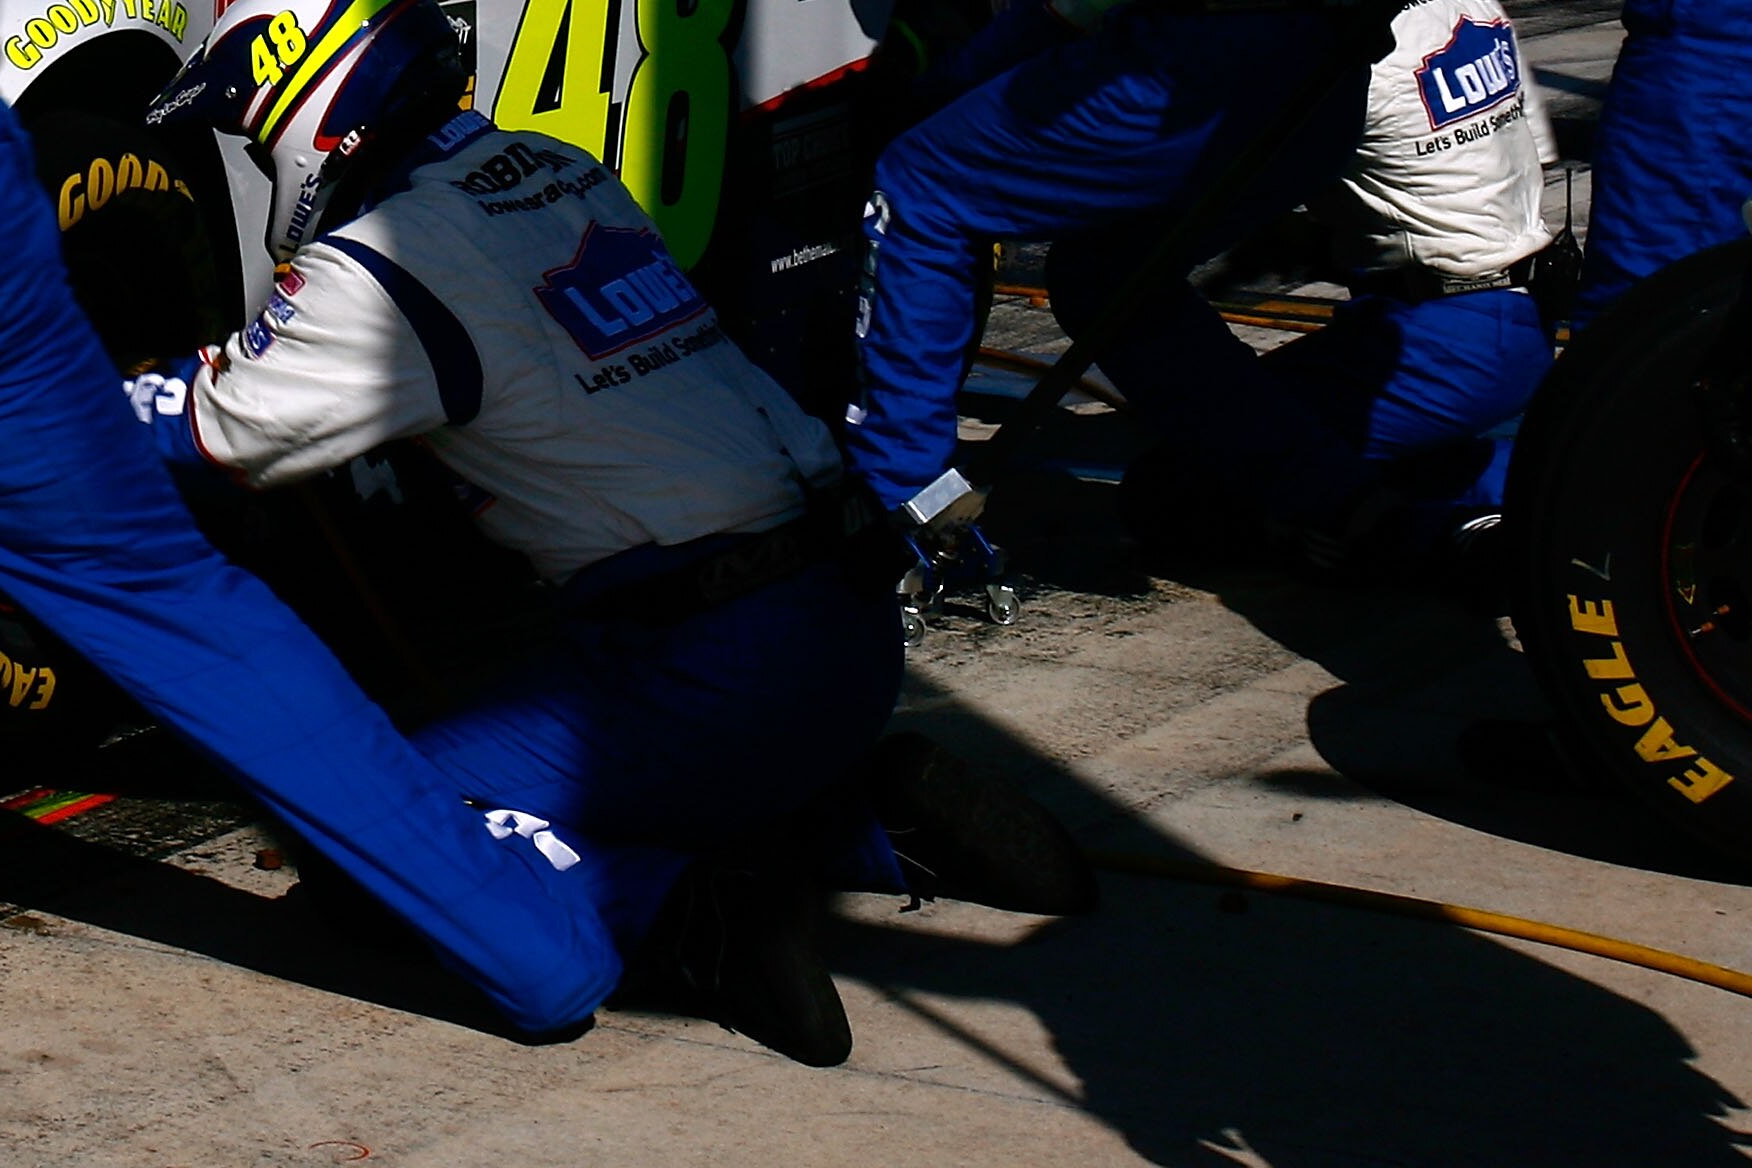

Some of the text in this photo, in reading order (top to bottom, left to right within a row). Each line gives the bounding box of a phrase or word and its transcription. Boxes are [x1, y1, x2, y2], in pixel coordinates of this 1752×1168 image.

[251, 10, 307, 87] 48
[1415, 132, 1453, 157] Let's
[1455, 121, 1491, 147] Build
[279, 172, 322, 254] LOWE'S
[574, 364, 632, 395] Let's
[627, 333, 681, 378] Build
[1566, 593, 1736, 805] EAGLE
